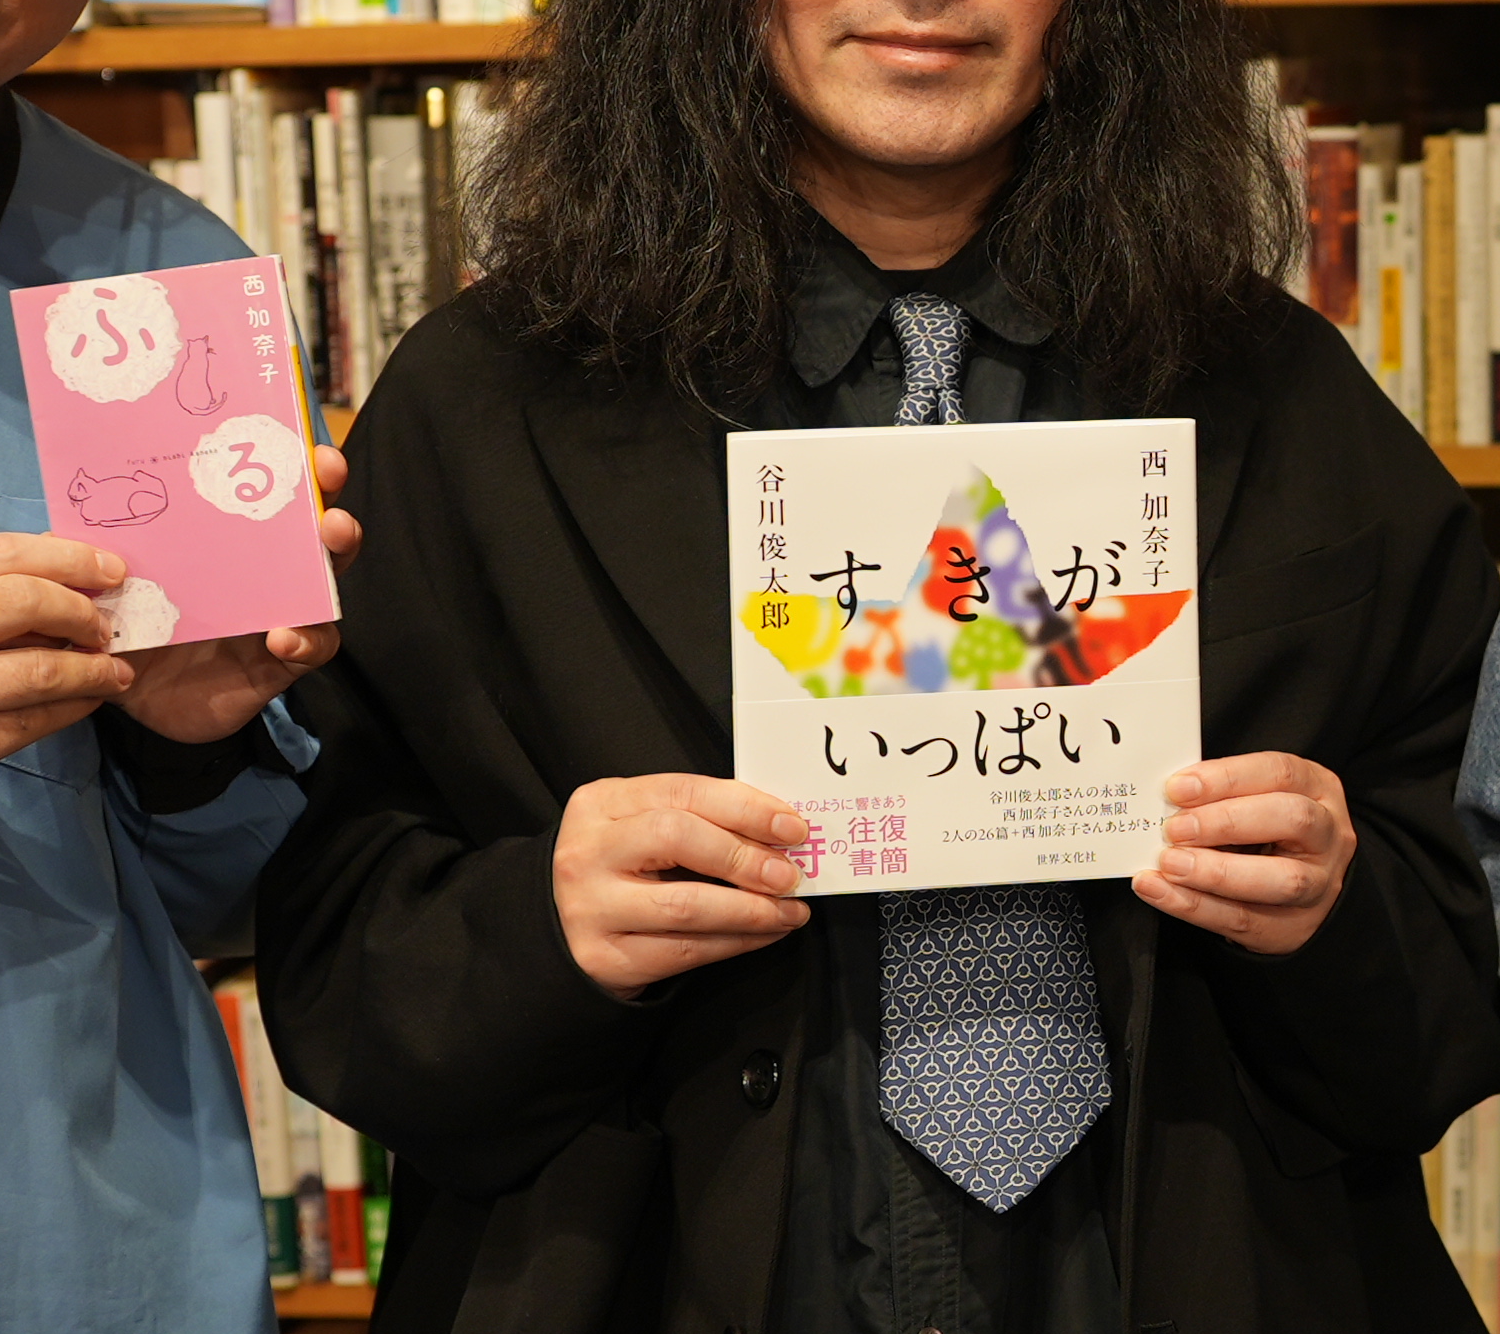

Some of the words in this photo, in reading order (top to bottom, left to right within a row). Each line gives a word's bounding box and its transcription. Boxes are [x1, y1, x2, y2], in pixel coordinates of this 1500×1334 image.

[242, 275, 279, 385] 西加奈子
[71, 287, 156, 366] ふ
[227, 441, 275, 503] る
[756, 463, 790, 631] 谷川俊太郎
[1140, 449, 1170, 588] 西加奈子
[809, 539, 1128, 631] すきが
[823, 701, 1122, 778] いっぱい
[787, 794, 907, 813] まのように響きあう
[990, 783, 1138, 805] 谷川俊太郎さんの永遠と
[1002, 801, 1128, 822] 西加奈子さんの無限
[1037, 851, 1097, 866] 世界文化社
